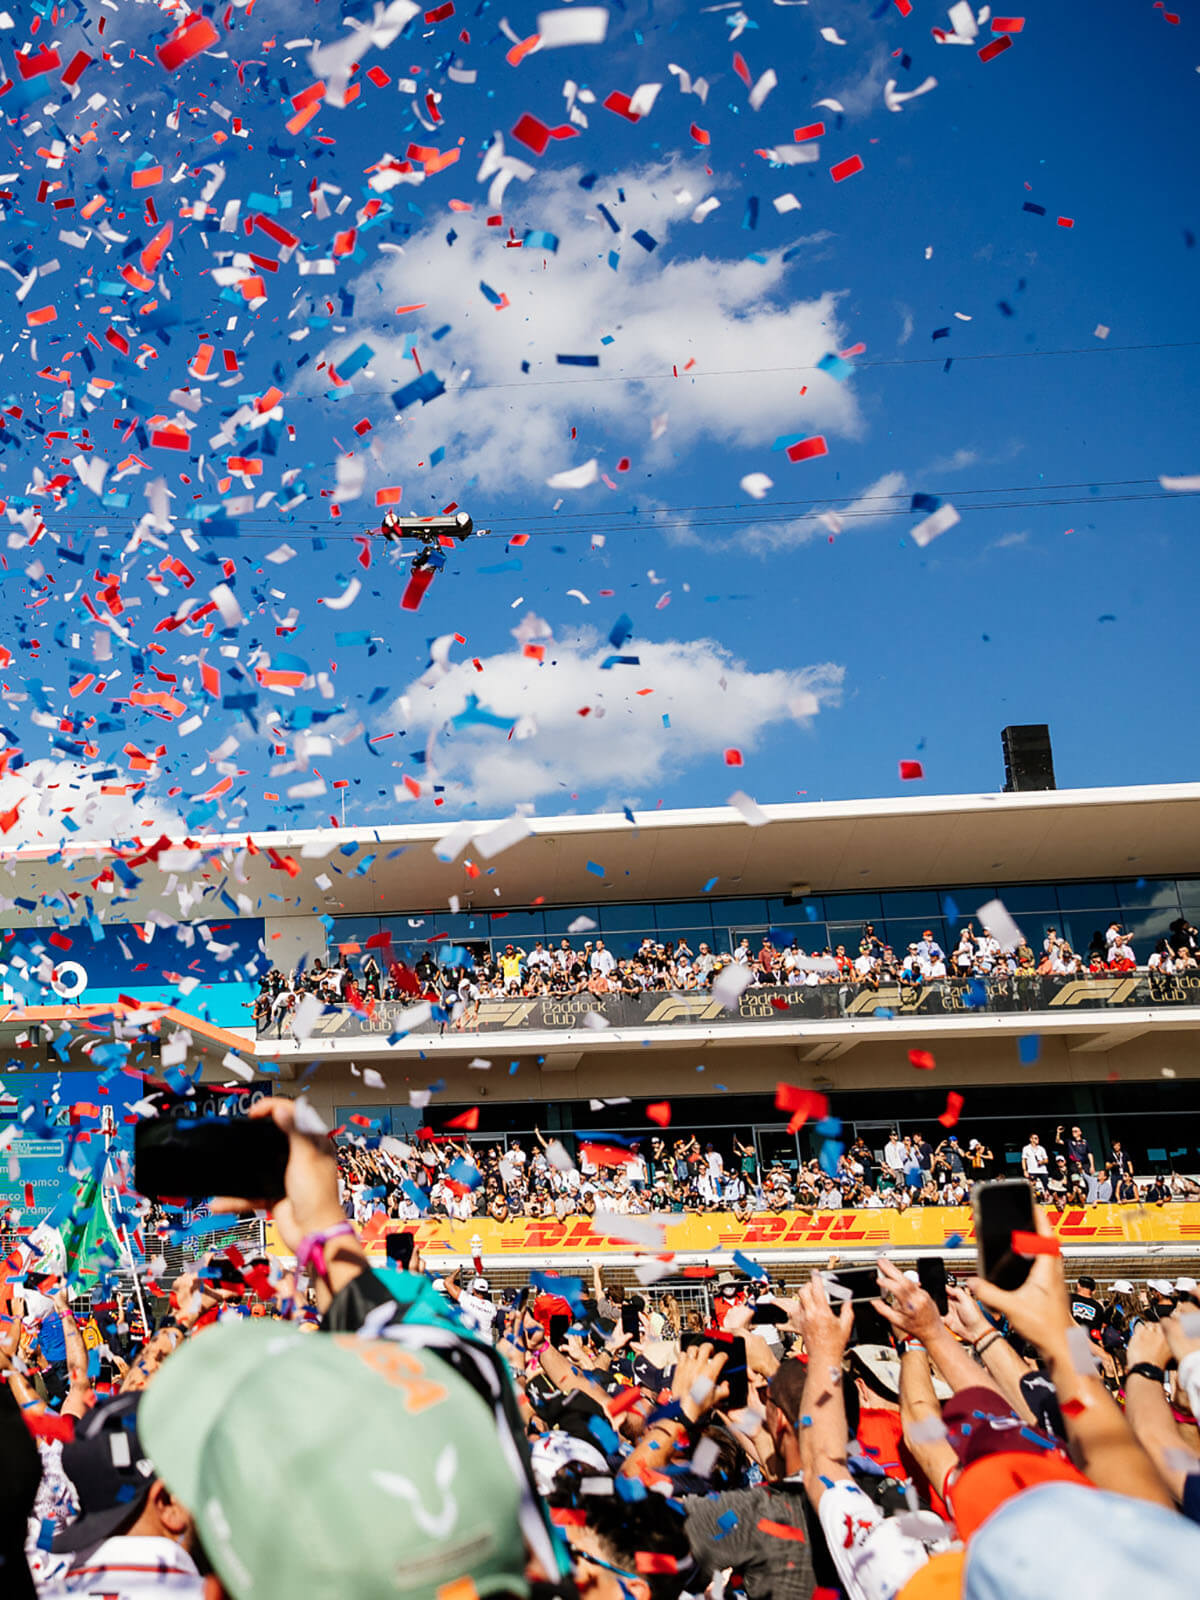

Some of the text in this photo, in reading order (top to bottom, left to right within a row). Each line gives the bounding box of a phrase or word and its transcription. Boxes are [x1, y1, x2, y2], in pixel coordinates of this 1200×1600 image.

[940, 982, 1008, 997] Padck
[542, 1001, 608, 1013] Paddock
[942, 994, 970, 1009] Clu
[740, 1004, 774, 1017] Club
[543, 1012, 576, 1025] Club
[170, 1090, 265, 1119] aamco
[19, 1206, 53, 1215] aramc
[742, 1215, 866, 1242] DHL
